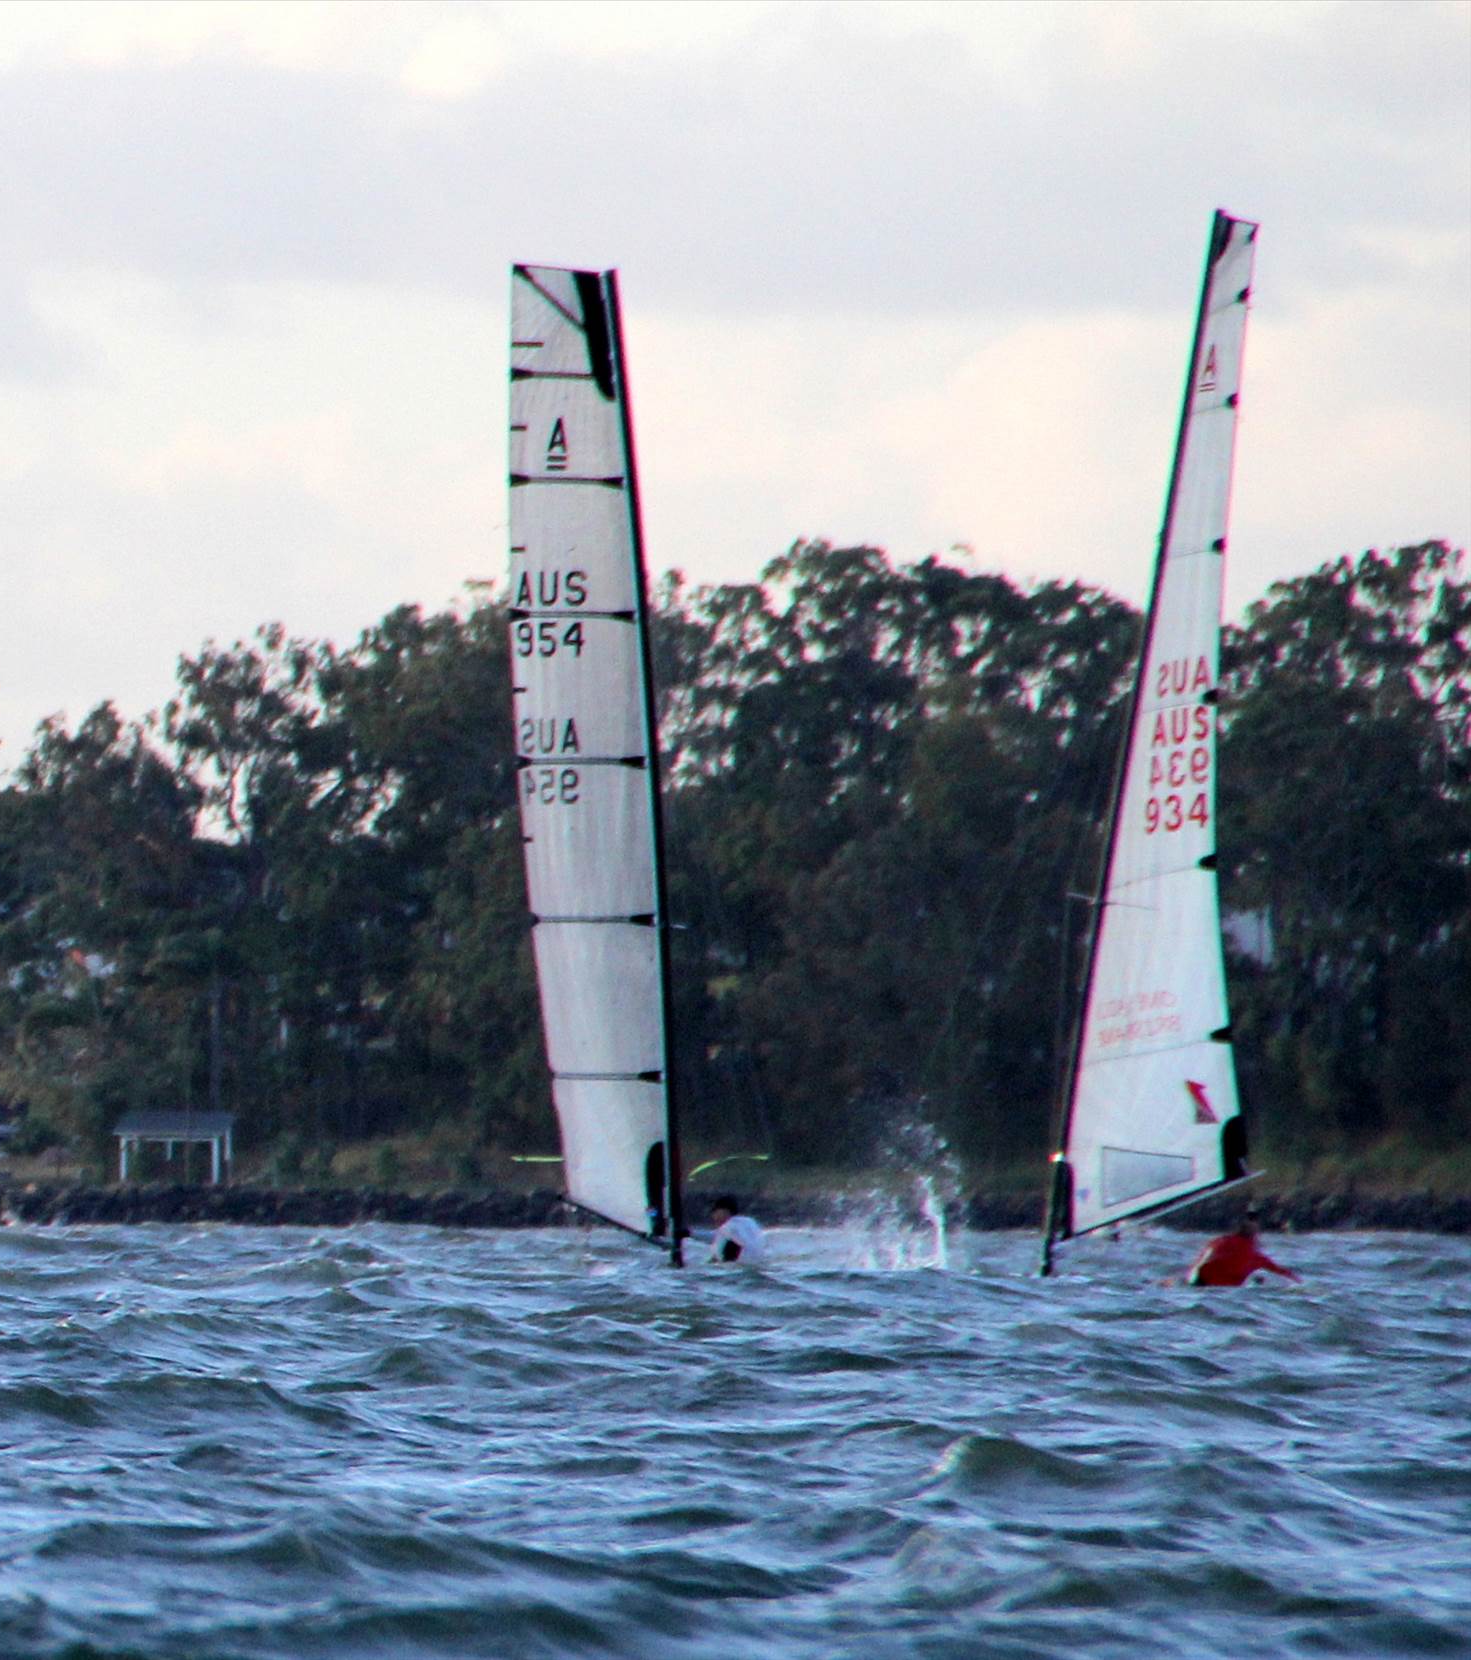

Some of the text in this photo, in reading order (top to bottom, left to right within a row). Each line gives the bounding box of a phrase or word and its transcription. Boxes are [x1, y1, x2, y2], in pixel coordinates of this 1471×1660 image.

[548, 417, 567, 454] A
[516, 571, 587, 607] AUS
[518, 622, 584, 658] 954
[1152, 706, 1209, 747] AUS
[1145, 793, 1209, 834] 934
